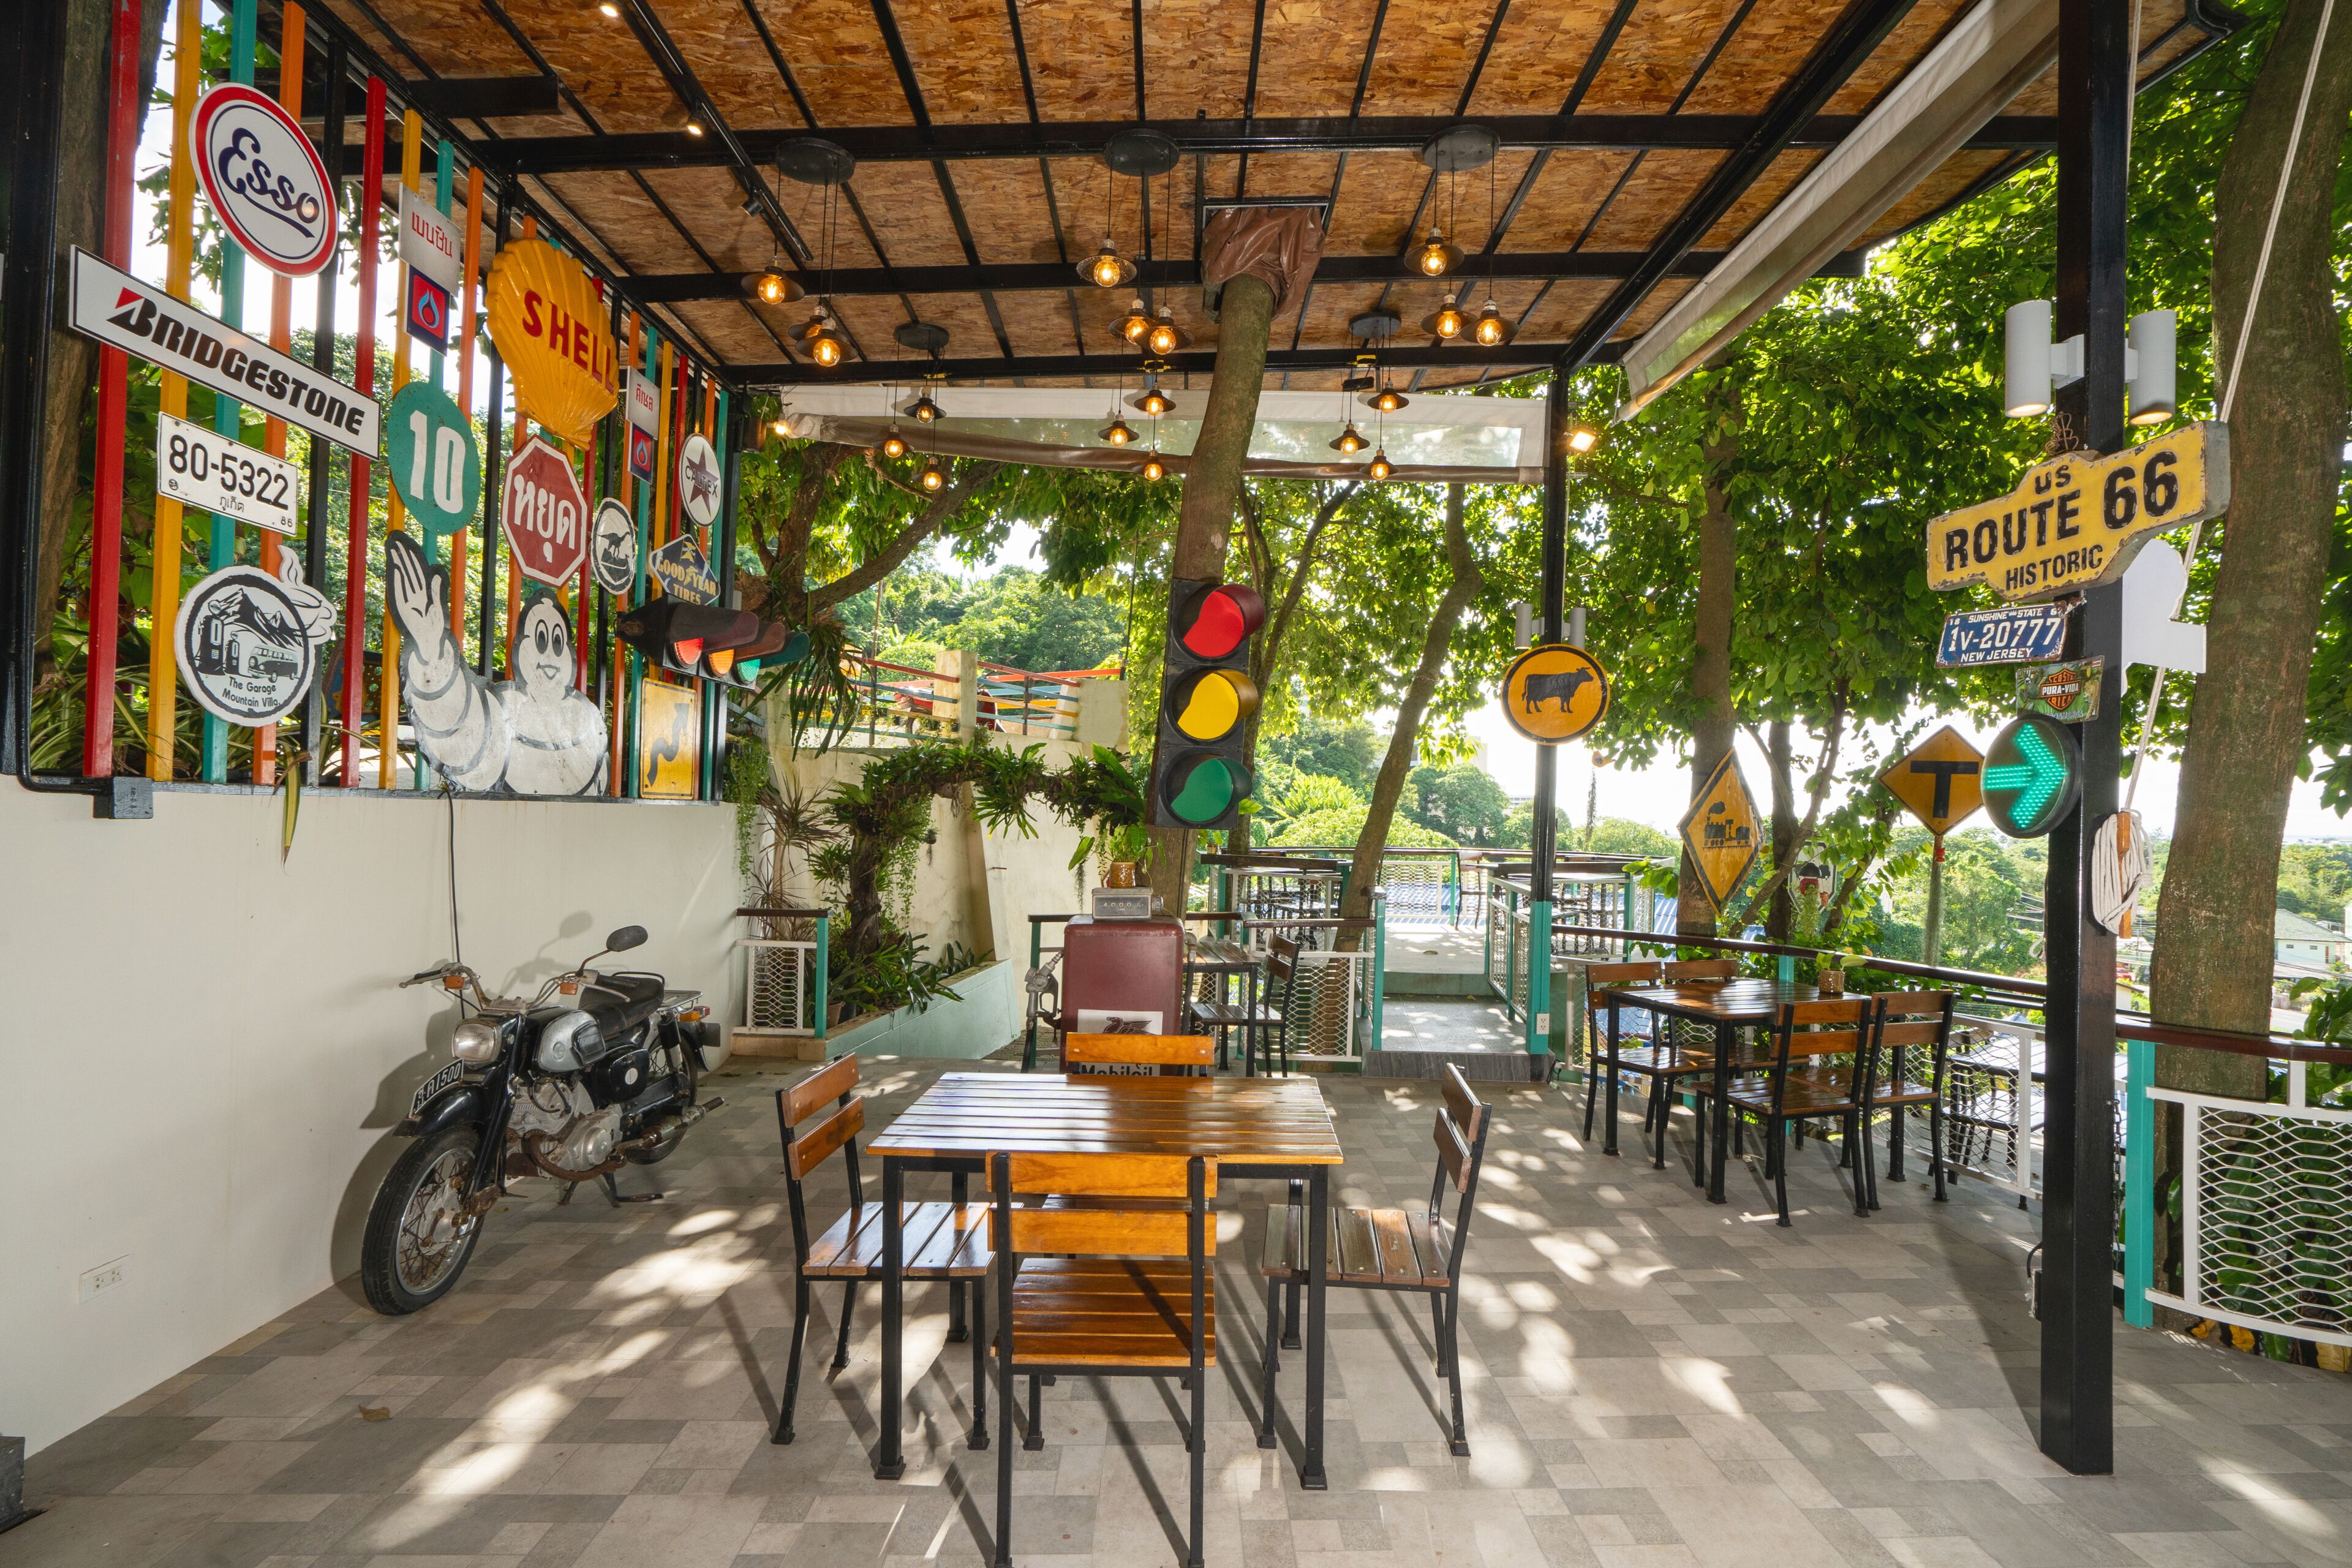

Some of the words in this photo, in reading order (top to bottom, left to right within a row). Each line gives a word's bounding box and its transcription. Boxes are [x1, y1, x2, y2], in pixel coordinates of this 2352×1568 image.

[219, 127, 320, 238] Esso
[522, 290, 614, 395] SHELL
[106, 286, 366, 436] BRIDGESTONE
[169, 434, 288, 511] 80-5322
[410, 409, 466, 514] 10
[685, 465, 718, 498] CALTEX
[2035, 464, 2071, 495] US
[219, 496, 245, 513] ภูเก็ต
[513, 474, 576, 564] หยุด
[1945, 488, 2081, 573] ROUTE
[2103, 450, 2179, 531] 66
[280, 516, 293, 527] 86
[2005, 544, 2103, 592] HISTORIC
[673, 583, 701, 605] TIRES
[1968, 611, 2008, 624] SUNSHINE
[2016, 608, 2044, 618] STATE
[1961, 652, 1985, 663] NEW
[1986, 647, 2034, 660] JERSEY
[222, 688, 259, 707] Mountain
[229, 676, 244, 690] The
[246, 682, 277, 695] Garage
[2042, 683, 2079, 696] PURA-VIDA
